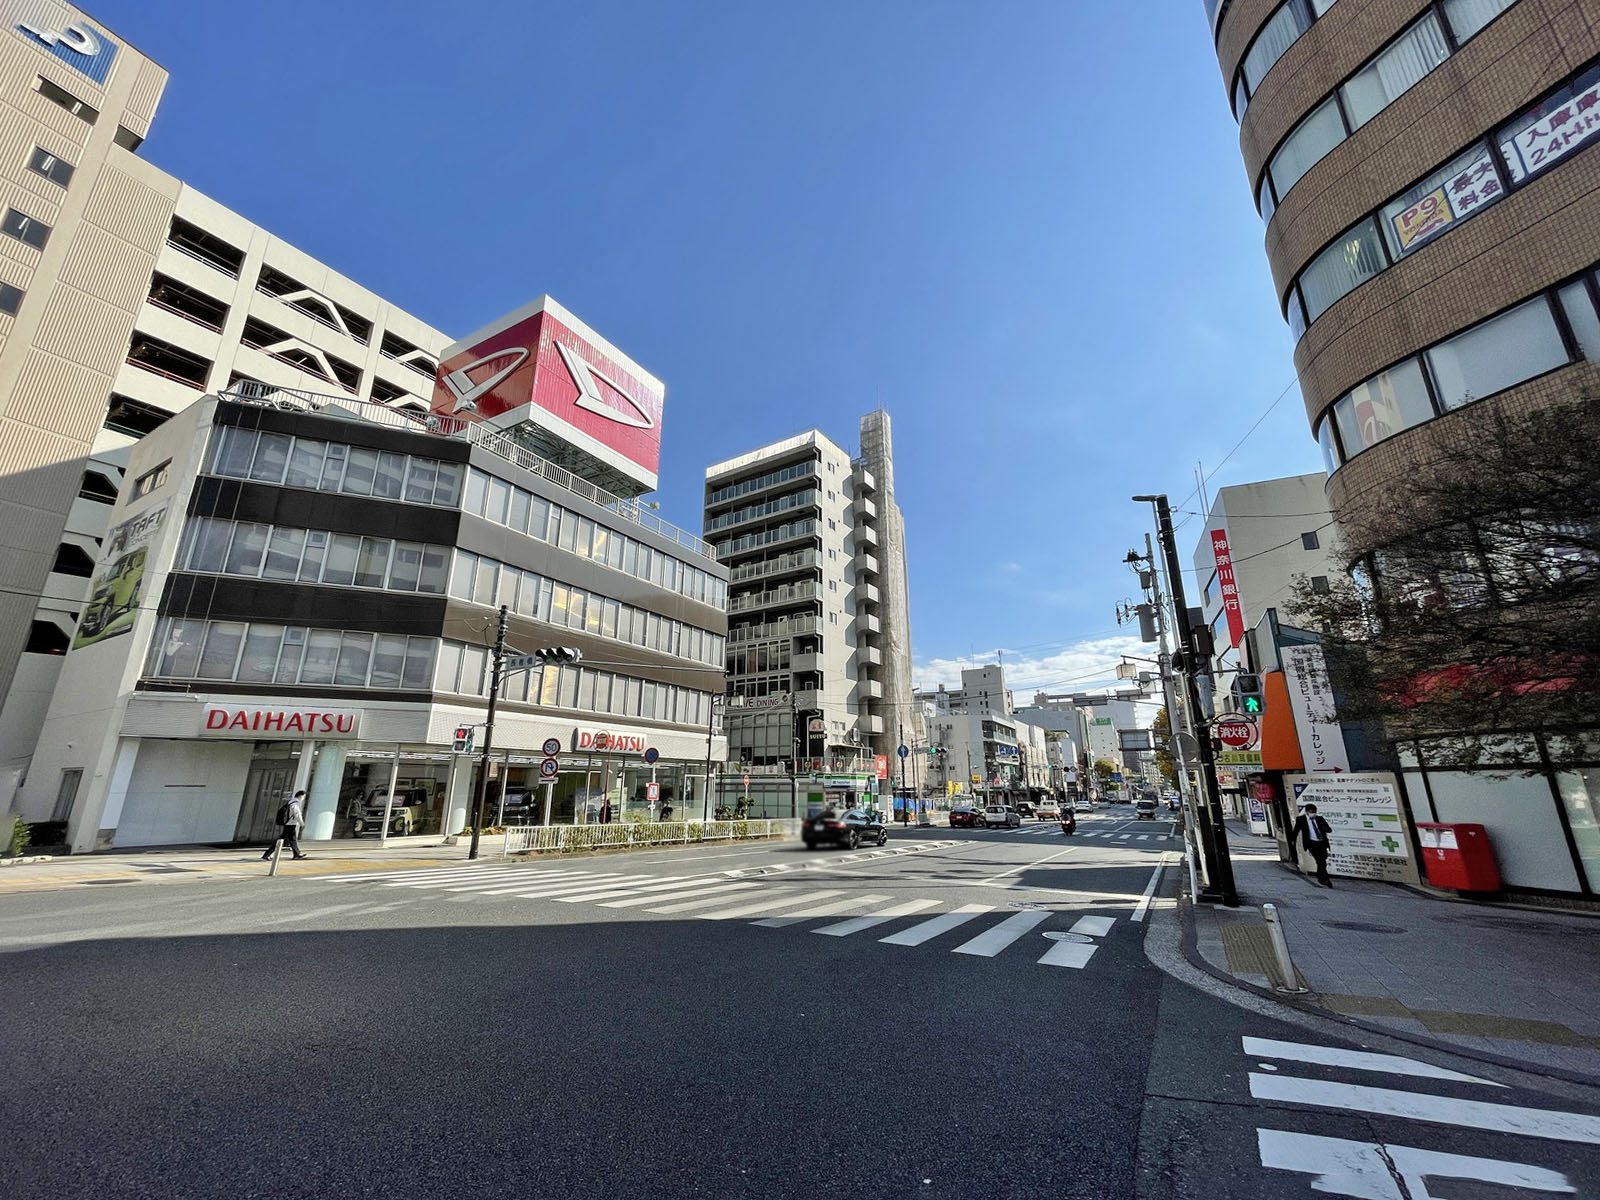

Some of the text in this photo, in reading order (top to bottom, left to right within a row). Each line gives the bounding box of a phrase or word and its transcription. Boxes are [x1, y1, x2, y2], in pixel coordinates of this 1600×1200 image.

[1457, 180, 1500, 211] 料金
[130, 507, 166, 537] TAFT
[1213, 540, 1239, 610] 神奈川銀行
[756, 698, 779, 707] DINING
[206, 708, 355, 733] DAIHATSU
[580, 731, 645, 752] DAHATSU
[1220, 727, 1249, 738] 消火栓
[546, 743, 558, 752] 50
